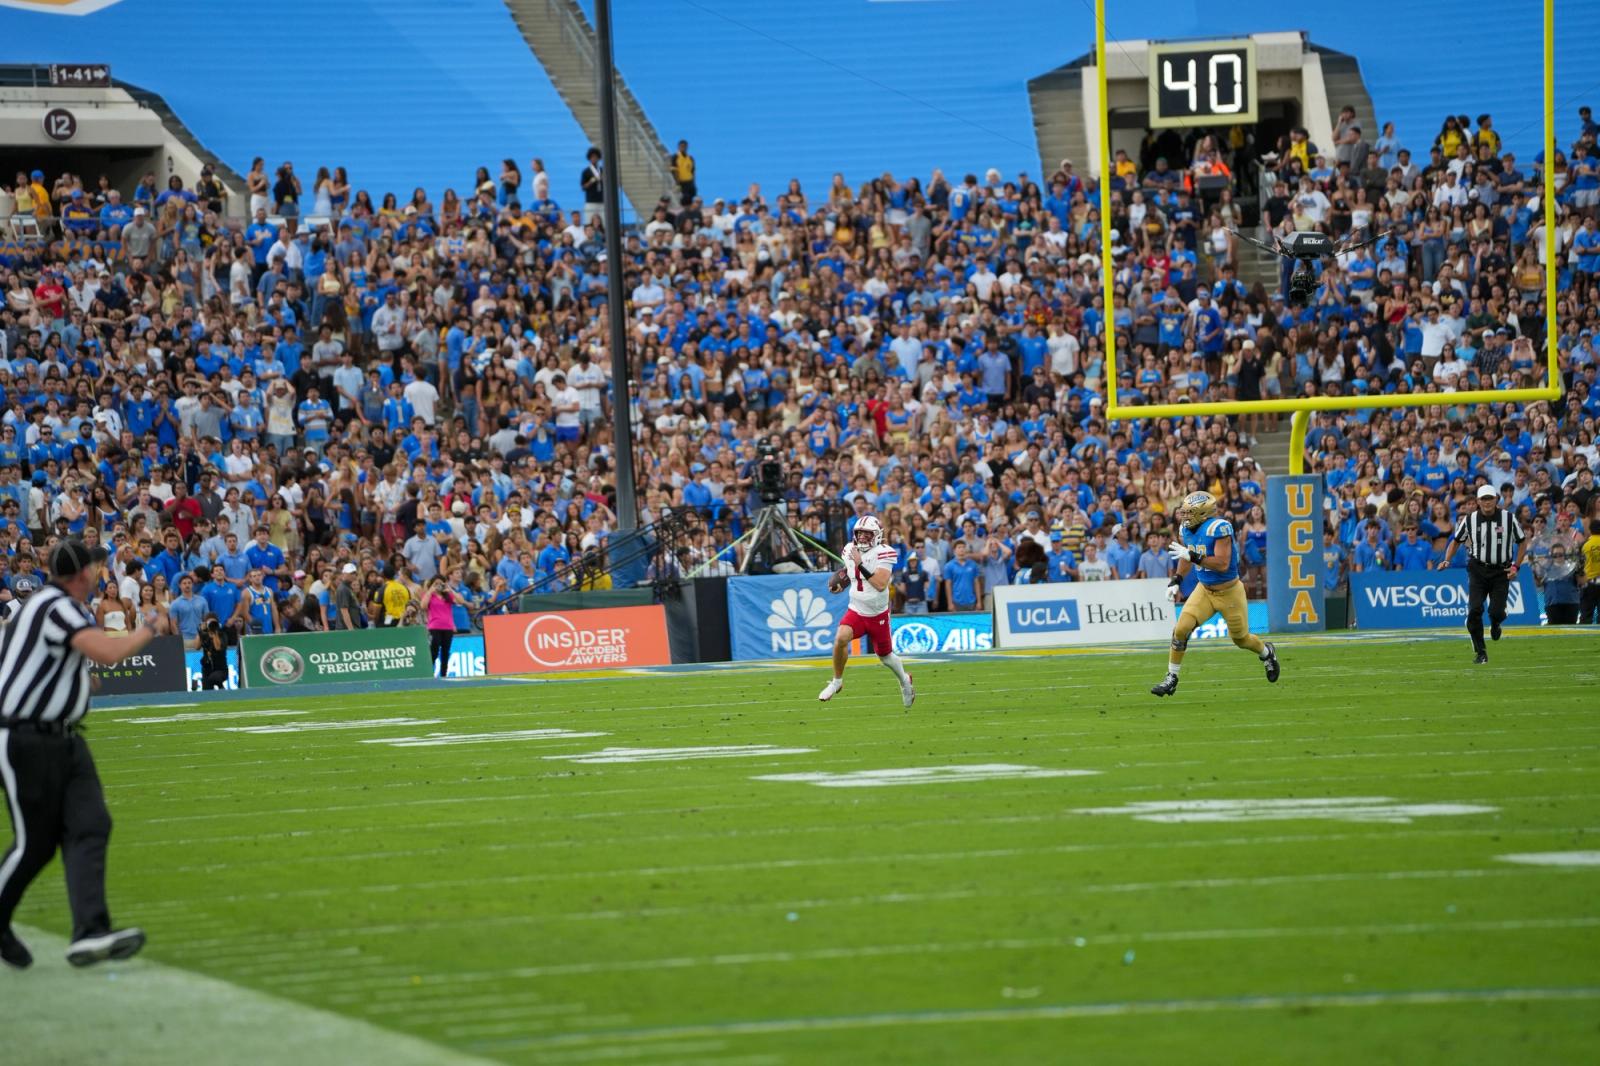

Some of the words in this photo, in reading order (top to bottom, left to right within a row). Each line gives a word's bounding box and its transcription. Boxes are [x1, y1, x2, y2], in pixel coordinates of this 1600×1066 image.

[60, 68, 92, 81] 1-41
[1163, 53, 1242, 113] 40
[50, 115, 71, 135] 12
[1285, 484, 1318, 624] UCLA
[1016, 607, 1071, 626] UCLA
[1422, 605, 1468, 617] Financi
[537, 628, 626, 649] INSIDER
[771, 629, 833, 652] NBC
[943, 628, 993, 652] Alls
[309, 652, 340, 664] OLD
[343, 646, 416, 662] DOMINION
[566, 653, 628, 665] LAWYERS
[571, 645, 626, 656] ACCIDENT
[91, 669, 143, 678] NERGY
[318, 660, 379, 675] FREIGHT
[384, 657, 414, 670] LINE
